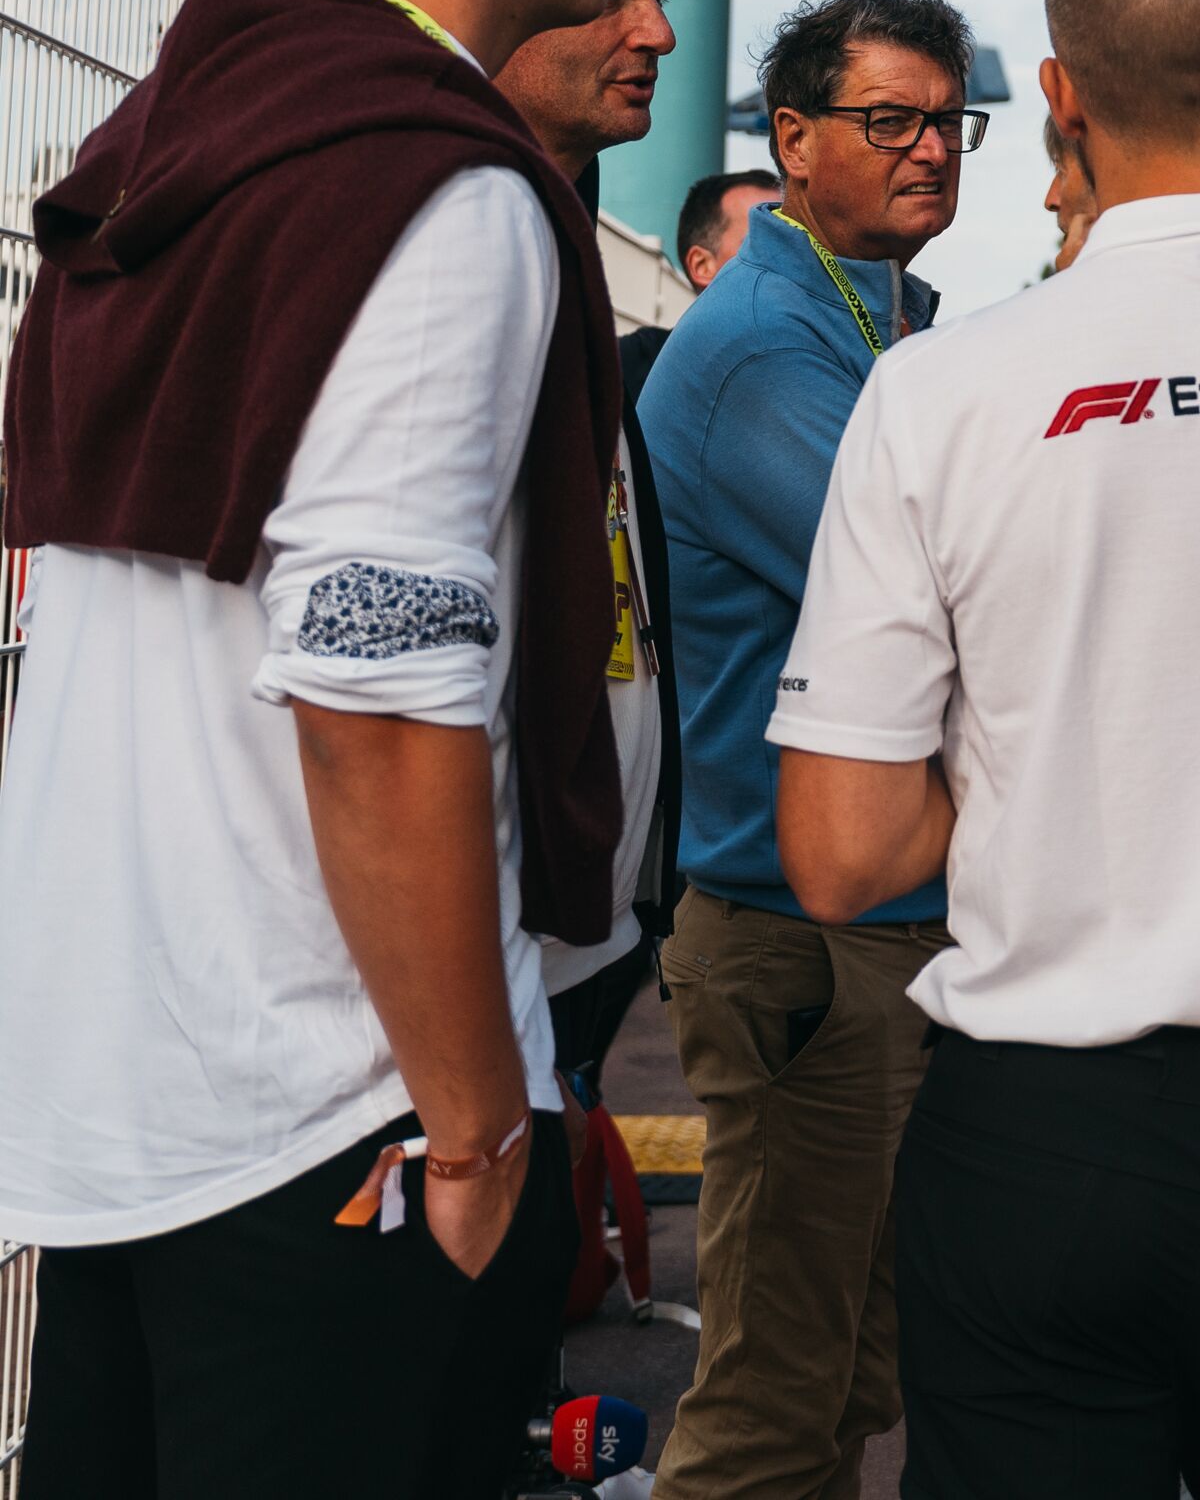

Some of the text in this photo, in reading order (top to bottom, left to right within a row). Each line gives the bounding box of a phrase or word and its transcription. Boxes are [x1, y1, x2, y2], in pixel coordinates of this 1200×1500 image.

[1044, 377, 1162, 439] F1
[572, 1417, 588, 1470] sport
[598, 1425, 620, 1463] sky
